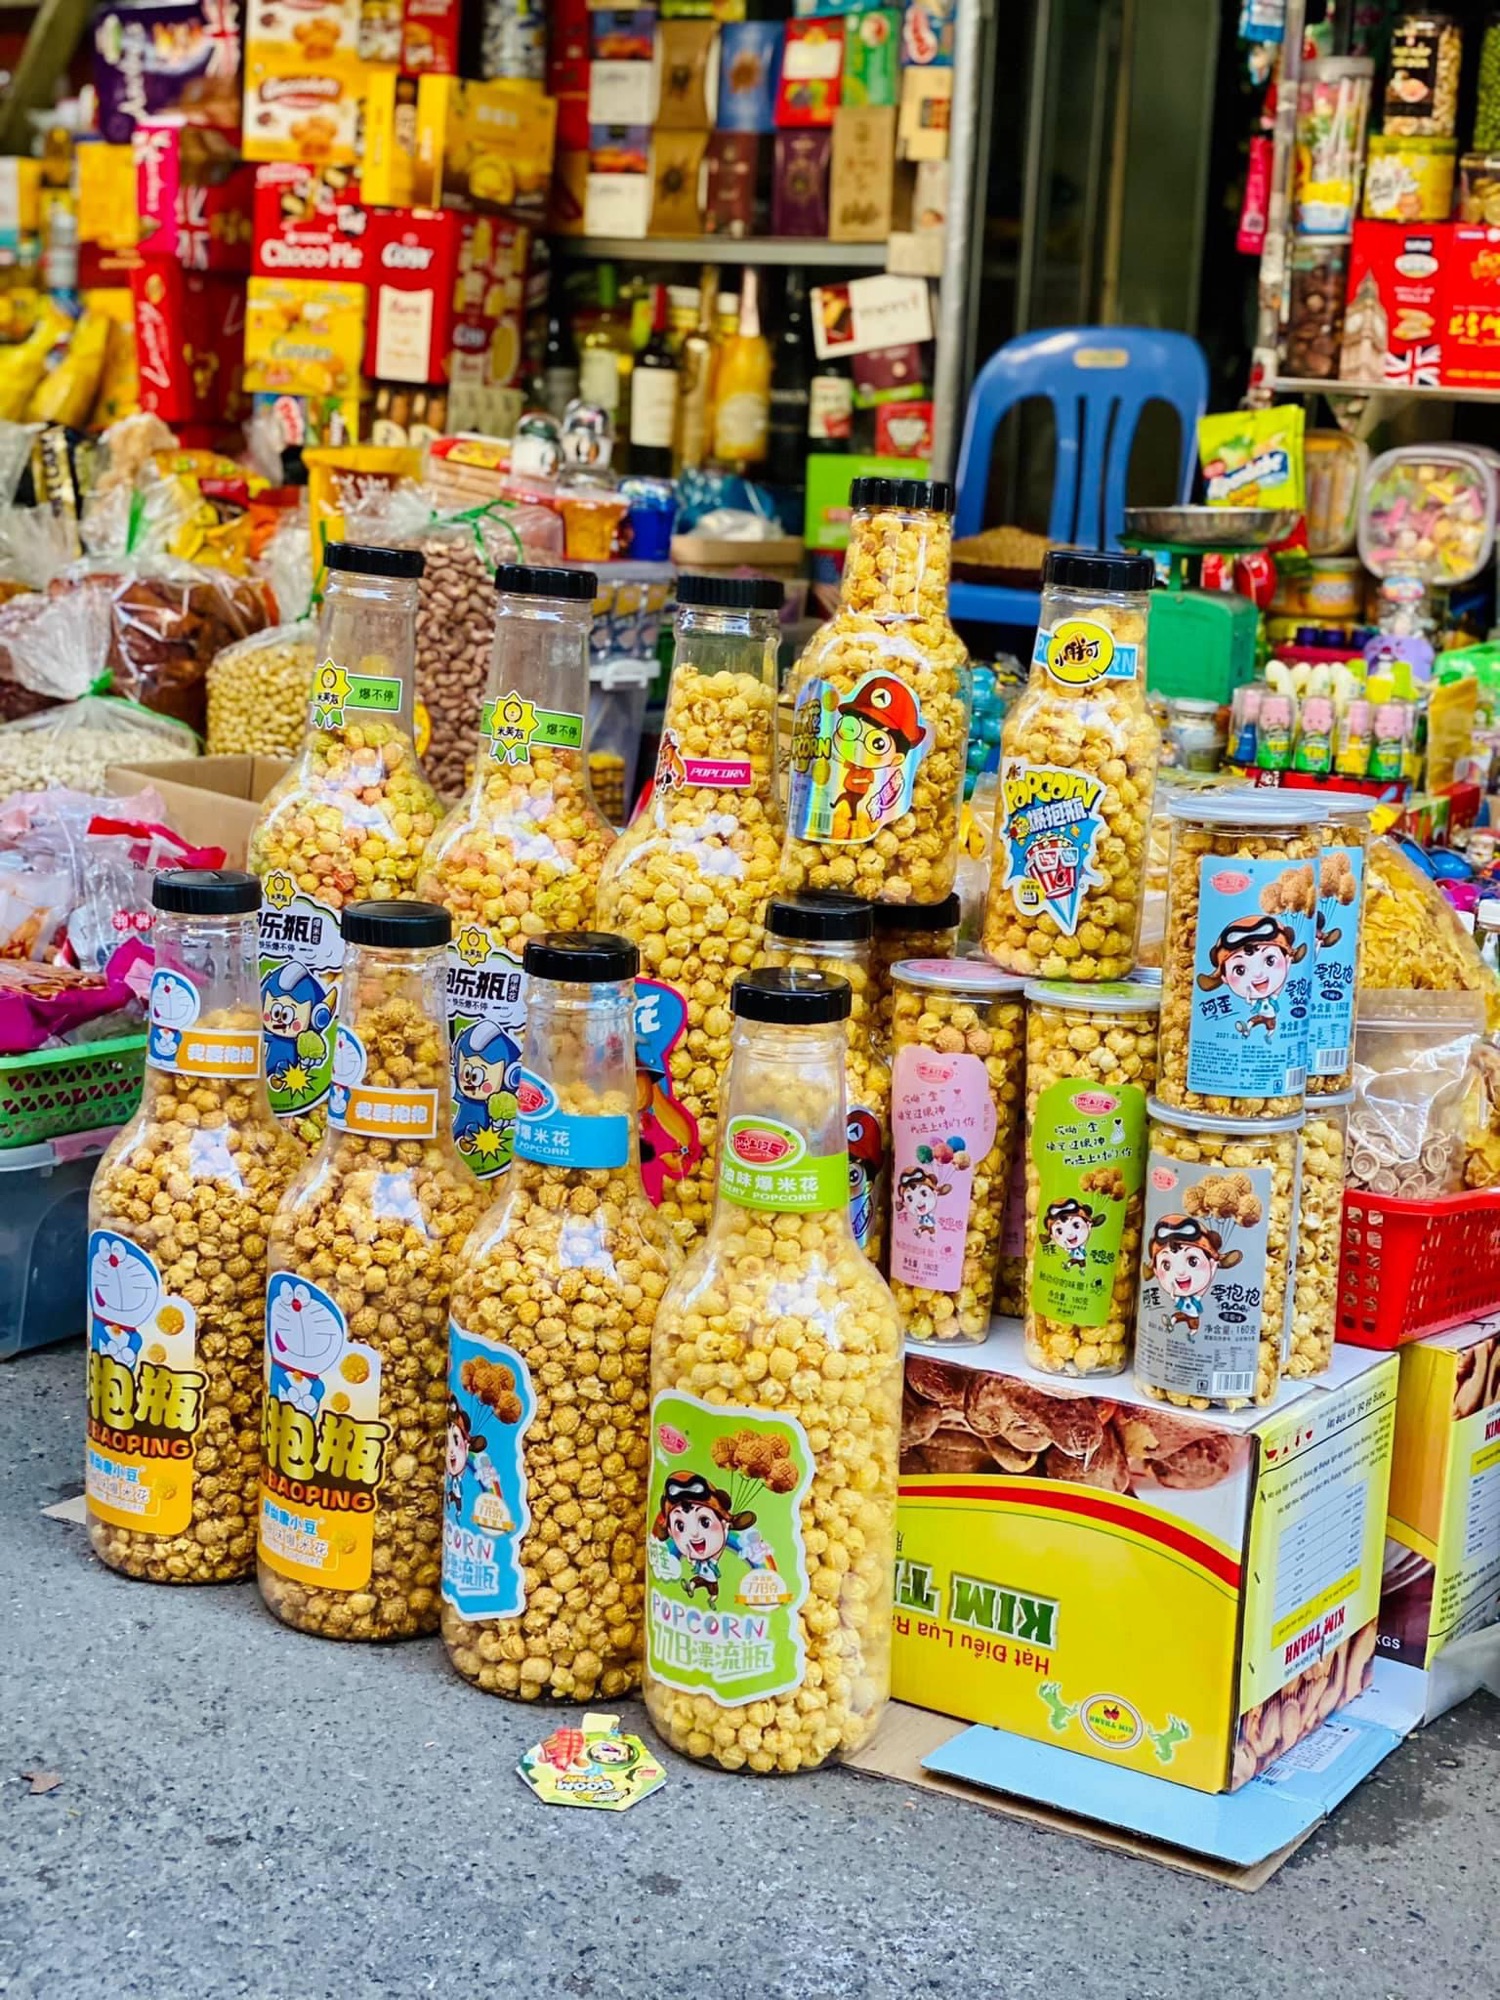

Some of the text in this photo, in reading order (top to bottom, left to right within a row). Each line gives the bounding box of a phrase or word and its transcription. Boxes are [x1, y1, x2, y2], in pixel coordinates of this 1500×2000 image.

[690, 767, 747, 778] POPCORN
[257, 912, 311, 943] 乐瓶
[752, 1190, 818, 1203] POPCORN
[652, 1593, 765, 1640] POPCORN
[893, 1560, 1057, 1650] KIM T
[1323, 1605, 1345, 1636] KIM
[891, 1613, 910, 1637] R
[917, 1620, 955, 1649] Lụa
[1284, 1623, 1321, 1666] THANH
[1013, 1646, 1050, 1677] Hạt
[556, 1779, 615, 1791] BOOM
